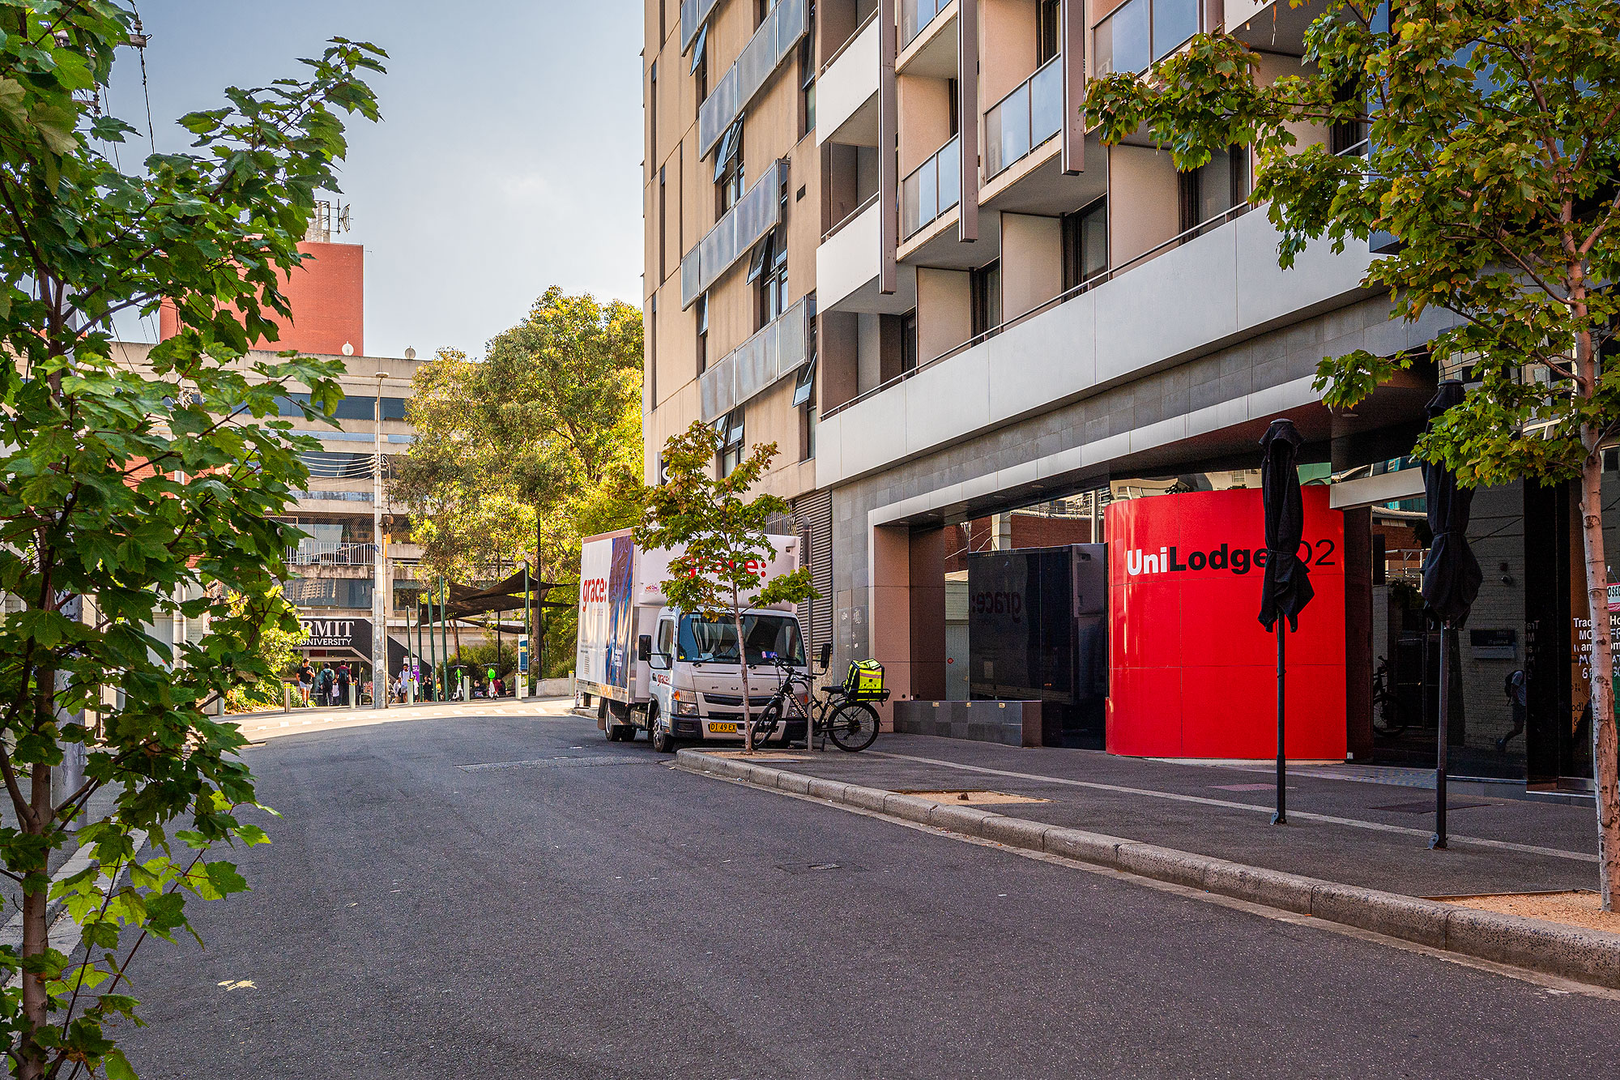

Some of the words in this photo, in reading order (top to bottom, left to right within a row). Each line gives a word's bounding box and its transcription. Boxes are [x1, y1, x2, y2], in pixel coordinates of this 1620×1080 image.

[1126, 543, 1268, 577] UniLodge
[583, 578, 607, 613] grace:
[300, 620, 355, 637] RMIT
[300, 638, 352, 646] UNIVERSITY
